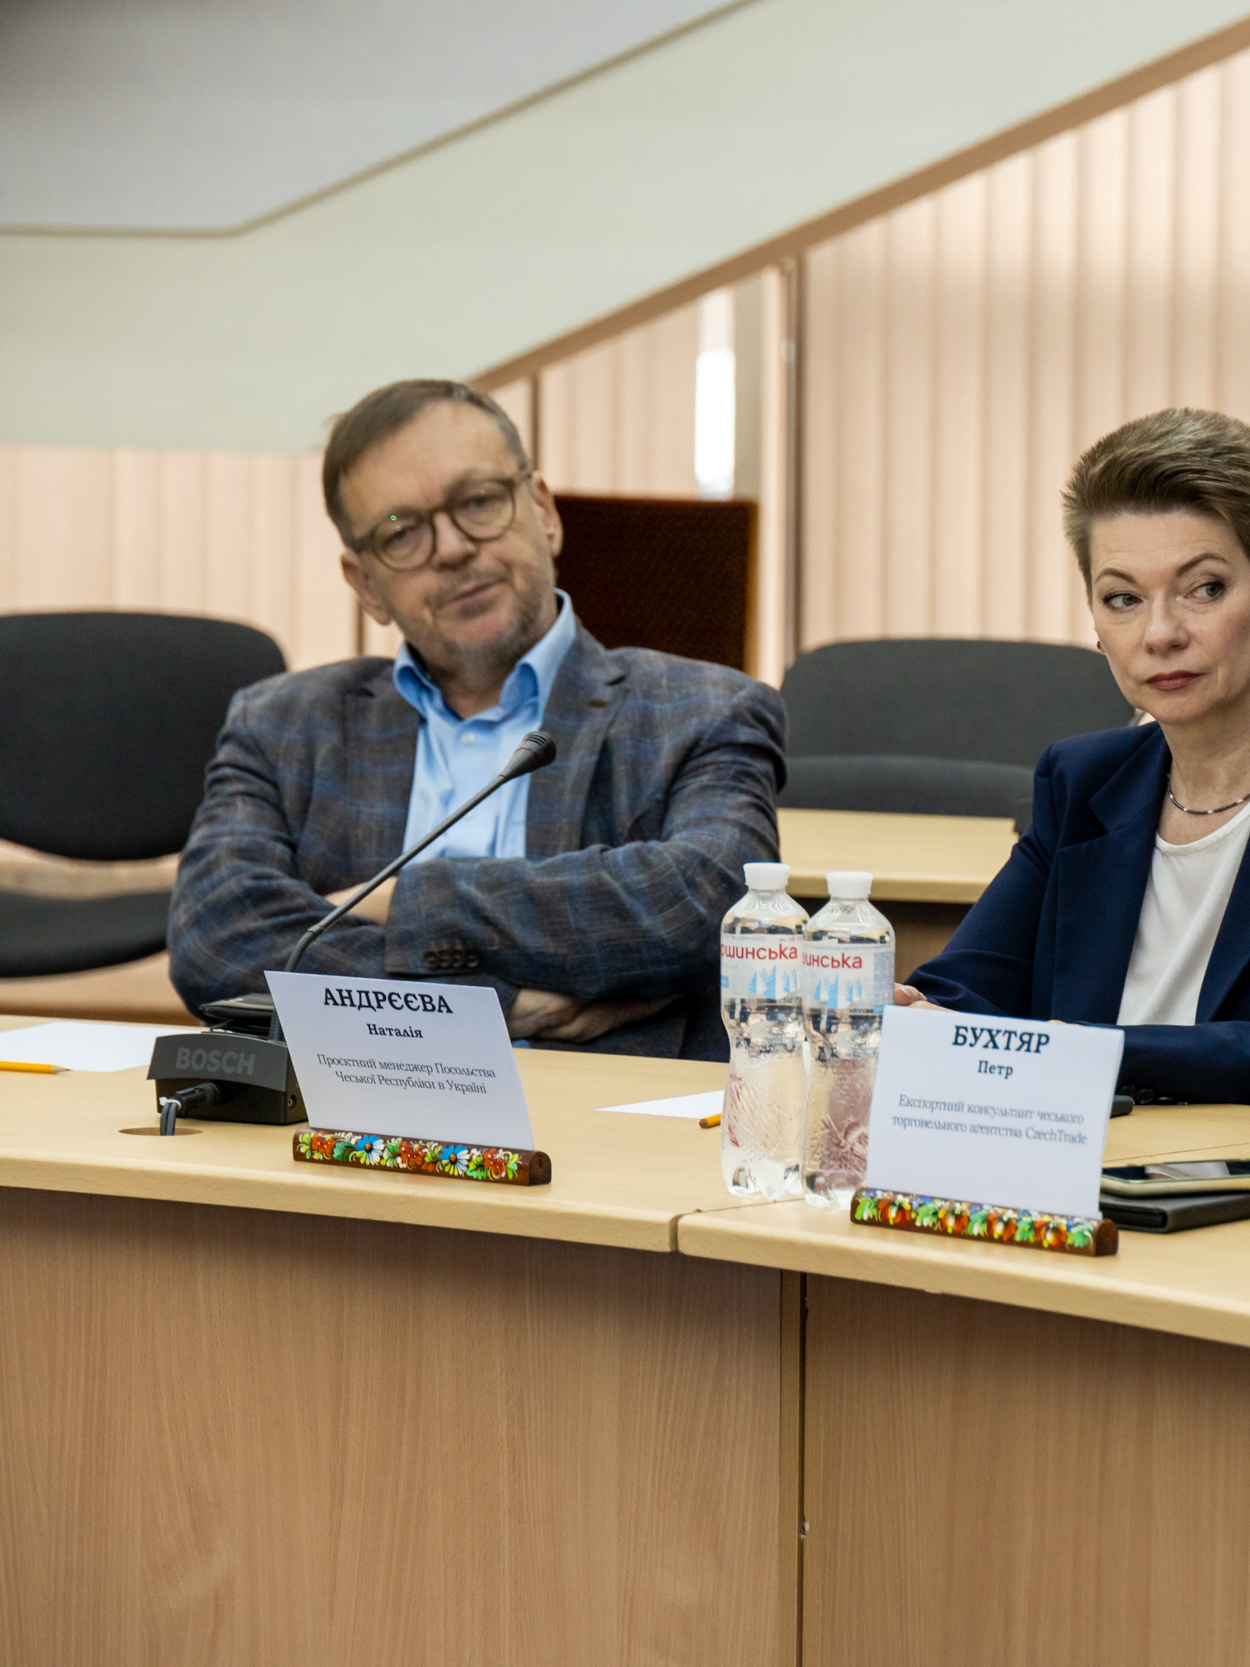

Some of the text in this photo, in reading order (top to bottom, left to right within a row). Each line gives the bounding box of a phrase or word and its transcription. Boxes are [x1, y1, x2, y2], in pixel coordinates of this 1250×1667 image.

[323, 987, 454, 1015] АНДРЄЄВА
[366, 1023, 424, 1039] Наталія
[952, 1025, 1050, 1054] БУХТЯР
[175, 1047, 256, 1076] BOSCH
[317, 1054, 497, 1078] Проєктний менеджер Посольства
[978, 1060, 1014, 1079] Петр
[335, 1071, 487, 1095] Чеської Республіки в Україні
[898, 1094, 1085, 1125] Експортний консультант чеського
[892, 1116, 1088, 1145] торговельного агентства CzechTrade
